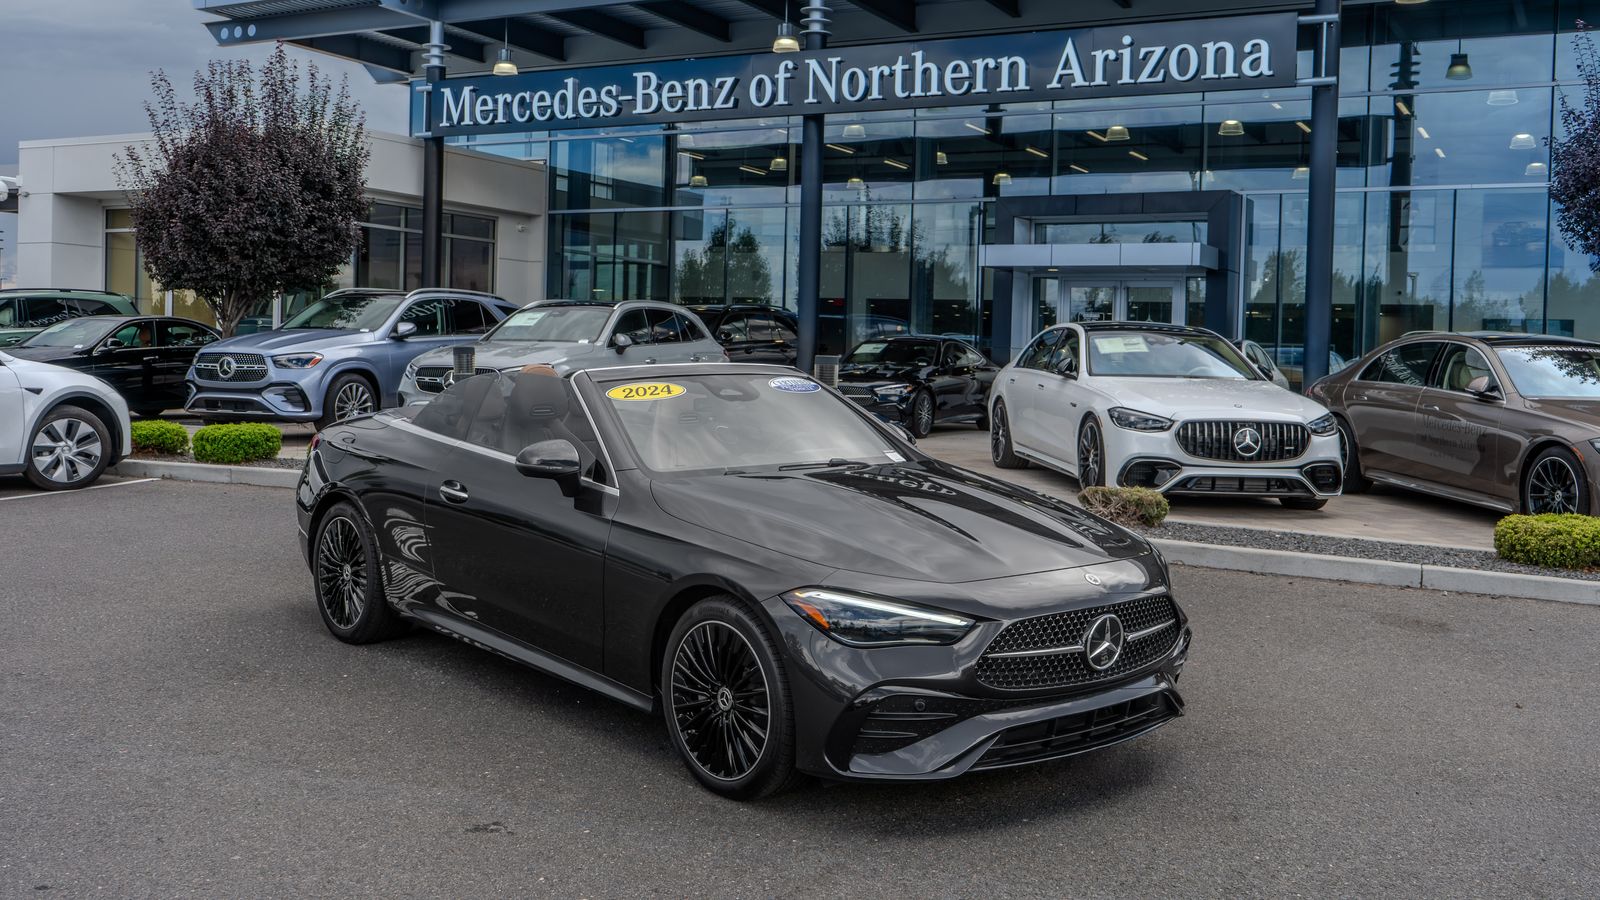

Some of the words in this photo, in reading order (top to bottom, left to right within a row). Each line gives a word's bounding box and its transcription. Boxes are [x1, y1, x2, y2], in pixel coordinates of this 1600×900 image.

[439, 71, 736, 127] Mercedes-Benz
[749, 59, 795, 107] of
[804, 49, 1030, 103] Northern
[1046, 35, 1274, 89] Arizona
[622, 384, 673, 399] 2024
